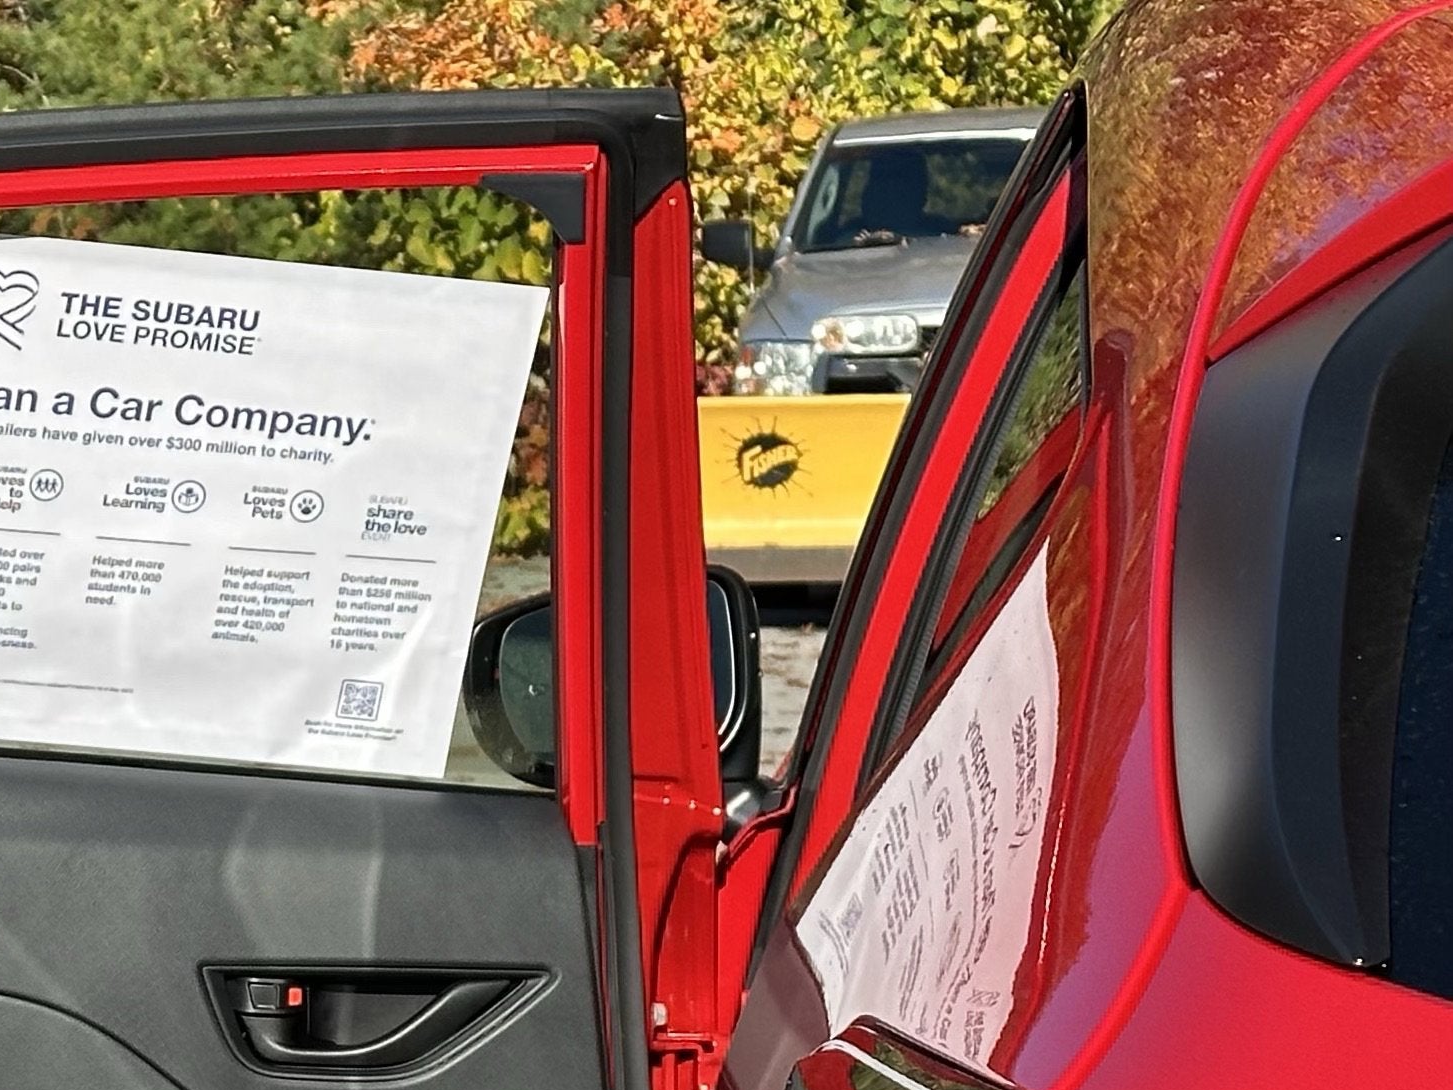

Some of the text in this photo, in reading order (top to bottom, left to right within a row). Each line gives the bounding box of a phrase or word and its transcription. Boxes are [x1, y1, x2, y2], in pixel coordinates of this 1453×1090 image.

[62, 293, 260, 331] THE SUBARU
[57, 320, 255, 355] LOVE PROMISE
[52, 392, 74, 415] a
[90, 387, 163, 422] Car
[175, 395, 373, 447] Company.
[42, 426, 78, 441] have
[82, 430, 124, 446] given
[128, 436, 163, 448] over
[166, 437, 202, 451] $300
[206, 441, 256, 456] million
[261, 445, 276, 457] to
[280, 447, 334, 465] charity.
[9, 486, 23, 498] to
[125, 483, 167, 498] Loves
[103, 494, 165, 513] Learning
[243, 493, 285, 507] Loves
[252, 506, 283, 520] Pets
[367, 505, 414, 521] share
[365, 520, 427, 535] the love
[19, 550, 45, 560] over
[12, 562, 41, 574] pairs
[92, 555, 165, 570] Helped more
[90, 567, 115, 579] than
[224, 565, 310, 581] Helped support
[341, 572, 419, 587] Donated more
[15, 576, 37, 586] and
[222, 578, 240, 589] the
[87, 581, 151, 596] students in
[338, 586, 363, 596] than
[394, 590, 431, 602] million
[11, 600, 22, 611] to
[263, 594, 314, 608] transport
[336, 599, 418, 614] to national and
[216, 605, 290, 619] and health of
[333, 612, 391, 626] hometown
[214, 618, 240, 628] over
[331, 626, 406, 640] charities over
